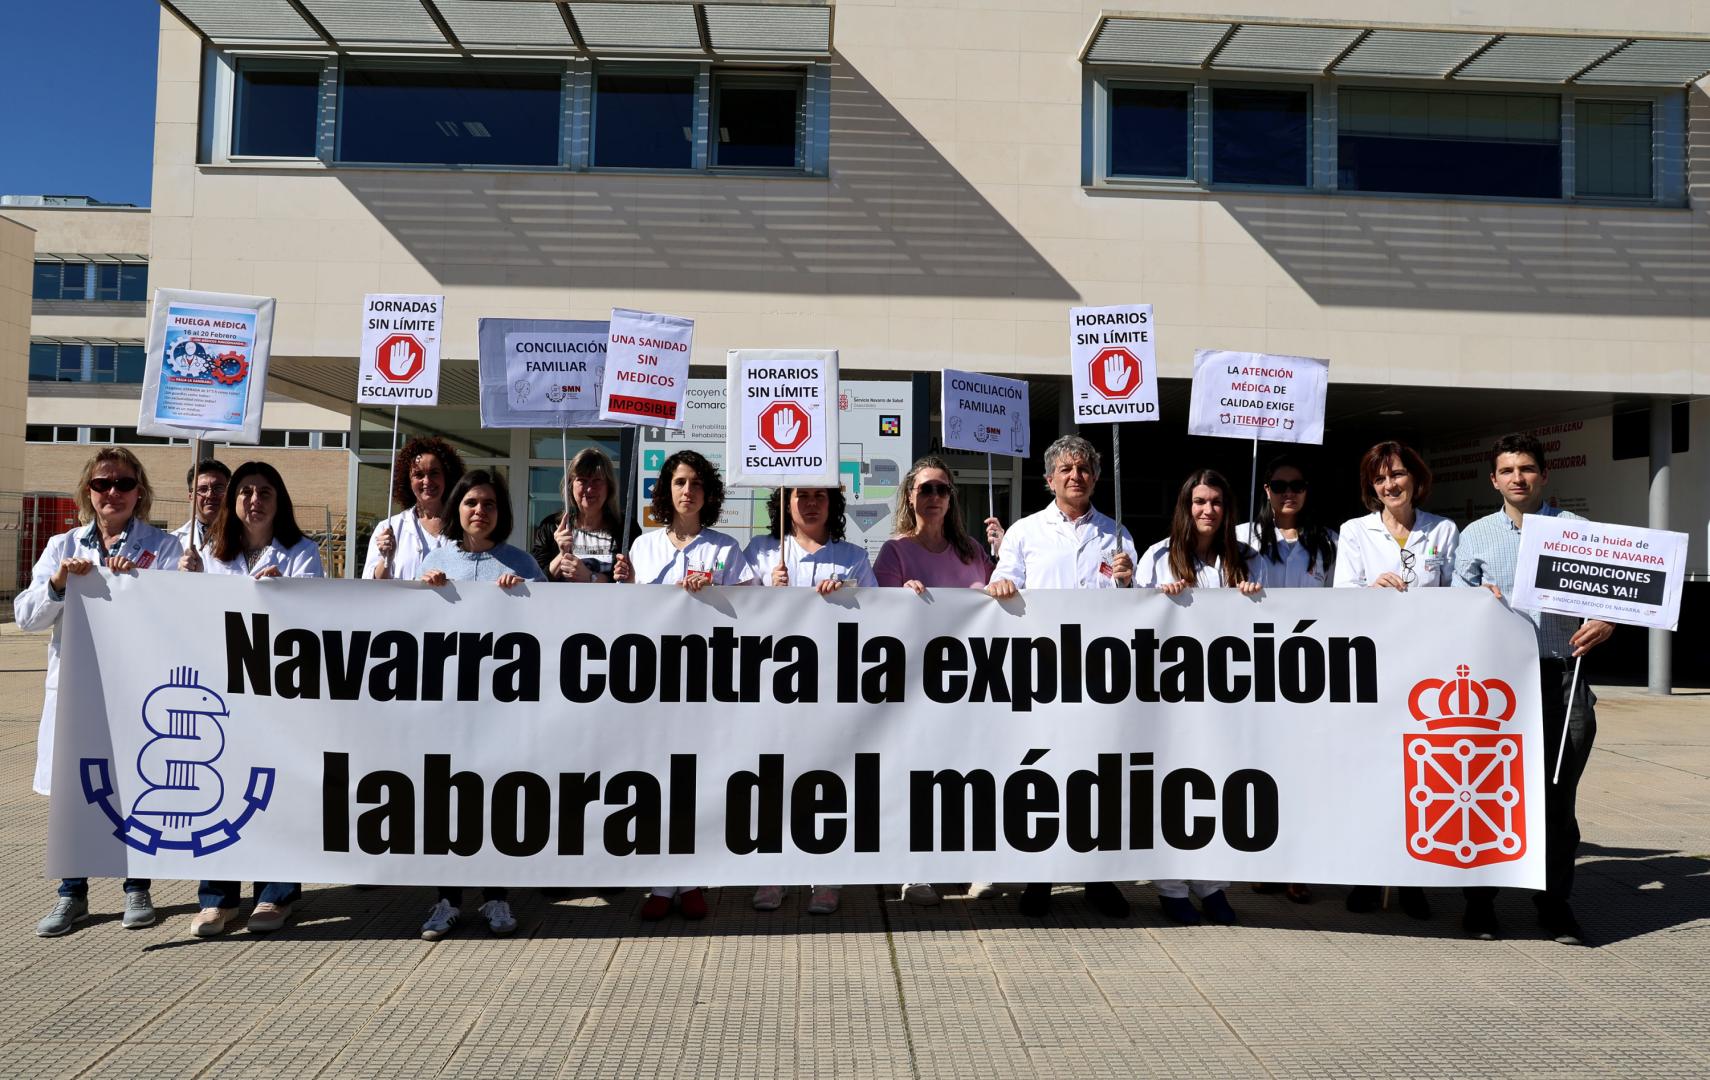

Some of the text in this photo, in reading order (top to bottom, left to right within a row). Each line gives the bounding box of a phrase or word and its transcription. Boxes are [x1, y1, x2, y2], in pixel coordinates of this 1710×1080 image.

[369, 301, 437, 313] JORNADAS
[174, 317, 247, 331] HUELGA MÉDICA
[369, 317, 435, 331] SIN LÍMITE
[1076, 312, 1147, 326] HORARIOS
[211, 331, 237, 339] Febrero
[1077, 329, 1148, 345] SIN LÍMITE
[516, 340, 607, 353] CONCILIACIÓN
[611, 334, 688, 352] UNA SANIDAD
[526, 361, 587, 372] FAMILIAR
[637, 354, 658, 366] SIN
[617, 370, 675, 387] MEDICOS
[747, 368, 819, 379] HORARIOS
[1227, 365, 1293, 379] LA ATENCIÓN
[361, 386, 433, 398] ESCLAVITUD
[747, 383, 819, 398] SIN LÍMITE
[951, 379, 1022, 400] CONCILIACIÓN
[1231, 381, 1286, 394] MÉDICA DE
[608, 397, 676, 416] IMPOSIBLE
[686, 400, 727, 409] Comarc
[959, 398, 1006, 415] FAMILIAR
[1078, 402, 1155, 416] ESCLAVITUD
[1220, 397, 1295, 411] CALIDAD EXIGE
[1232, 415, 1279, 427] ¡TIEMPO!
[986, 427, 1001, 435] SMN
[746, 456, 823, 467] ESCLAVITUD
[1562, 530, 1579, 540] NO
[1590, 534, 1600, 543] la
[1602, 536, 1632, 548] huida
[1635, 540, 1649, 550] de
[1543, 541, 1665, 565] MÉDICOS DE NAVARRA
[1551, 561, 1651, 584] ¡¡CONDICIONES
[1559, 578, 1638, 599] DIGNAS YA!!
[1552, 596, 1581, 605] SINDICATO
[1614, 605, 1641, 614] NAVARRA
[225, 612, 1377, 712] Navarra contra la explotación
[323, 748, 1279, 857] laboral del médico
